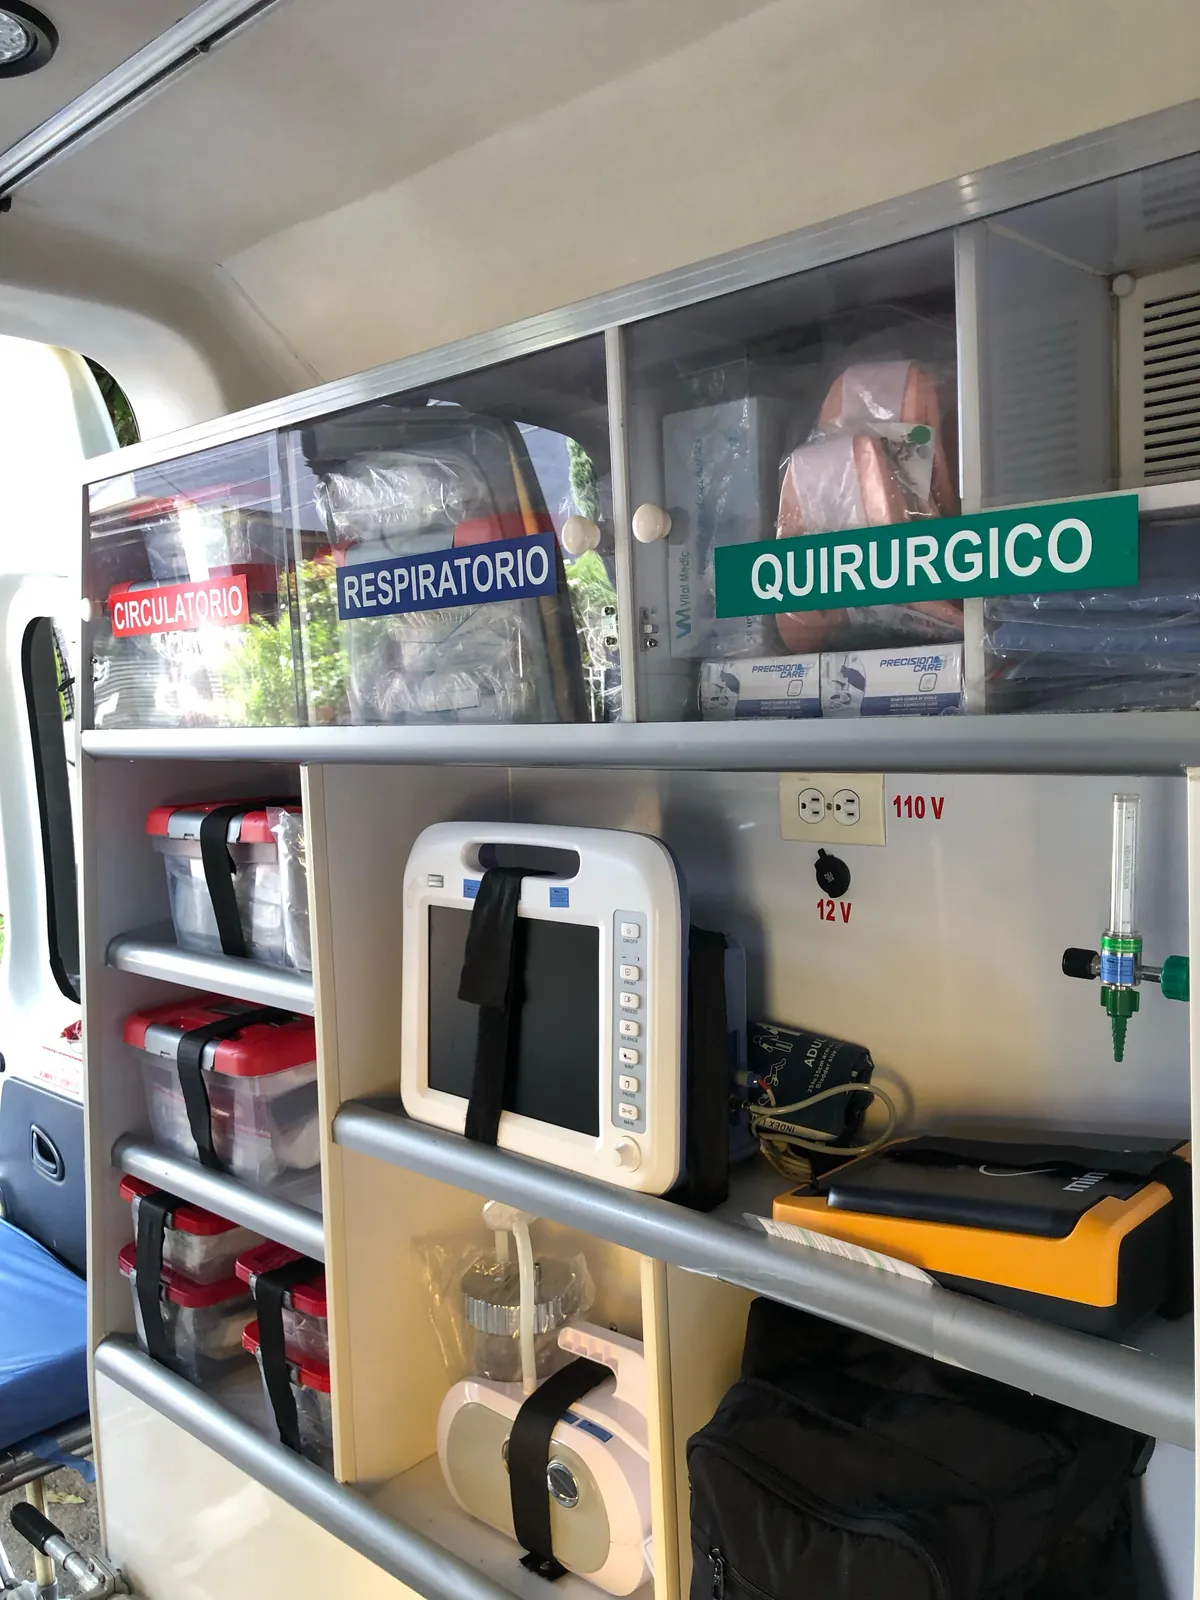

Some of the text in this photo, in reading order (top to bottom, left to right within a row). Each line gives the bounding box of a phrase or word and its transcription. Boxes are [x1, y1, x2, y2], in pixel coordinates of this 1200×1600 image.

[678, 551, 690, 581] Medic
[750, 517, 1094, 603] QUIRURGICO
[344, 544, 550, 610] RESPIRATORIO
[679, 583, 691, 606] Vital
[113, 584, 244, 631] CIRCULATORIO
[751, 664, 798, 673] PRECISION
[880, 656, 934, 668] PRECISION
[913, 663, 943, 673] CARE
[780, 670, 805, 679] CARE
[893, 794, 945, 820] 110 V
[816, 898, 852, 924] 12 V
[804, 1038, 828, 1067] ADUL
[768, 1120, 796, 1133] INDEX
[1062, 1171, 1109, 1193] min
